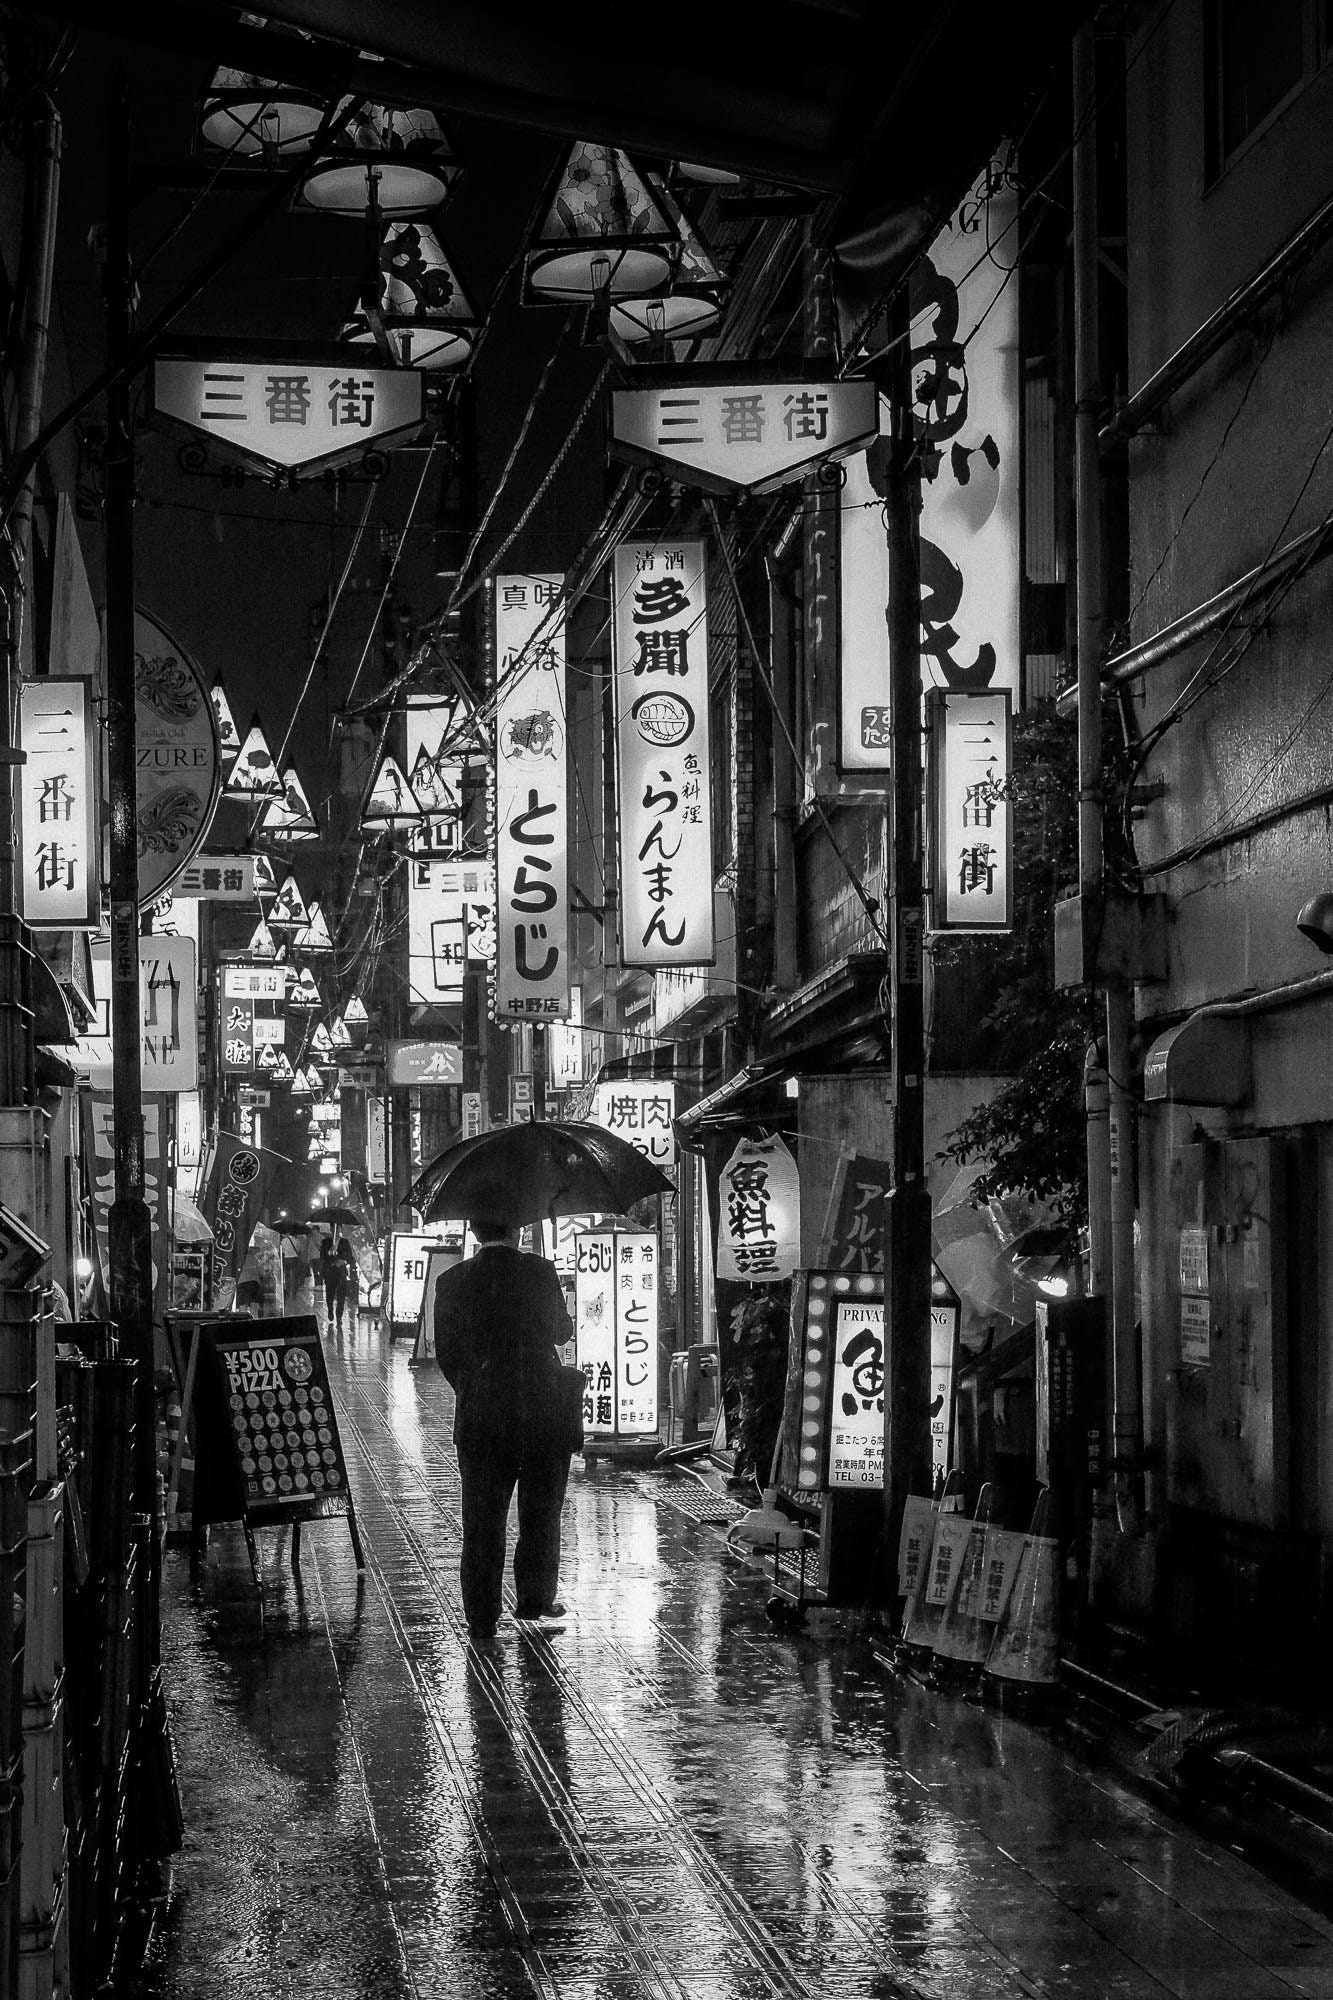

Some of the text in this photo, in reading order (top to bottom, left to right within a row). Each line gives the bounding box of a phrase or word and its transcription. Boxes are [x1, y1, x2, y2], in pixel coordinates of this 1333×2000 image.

[200, 373, 374, 428] 三番街
[657, 392, 829, 445] 三番街
[635, 550, 685, 571] 清酒
[631, 577, 691, 677] 多聞
[137, 748, 208, 767] ZURE
[31, 709, 79, 891] 三番街
[682, 753, 703, 824] 魚料理
[957, 719, 999, 895] 三番街
[638, 770, 686, 948] らんまん
[181, 868, 244, 891] 三番街
[509, 788, 559, 981] とらじ
[508, 997, 560, 1014] 中野店
[607, 1095, 672, 1129] 焼肉
[552, 1214, 595, 1249] 肉
[727, 1160, 781, 1274] 魚料理
[404, 1260, 424, 1280] 和
[577, 1242, 612, 1273] とらじ
[624, 1299, 649, 1387] とらじ
[224, 1348, 278, 1373] ¥500
[229, 1369, 285, 1393] PIZZA
[834, 1472, 885, 1483] TEL 03-
[835, 1459, 866, 1471] 営業時間
